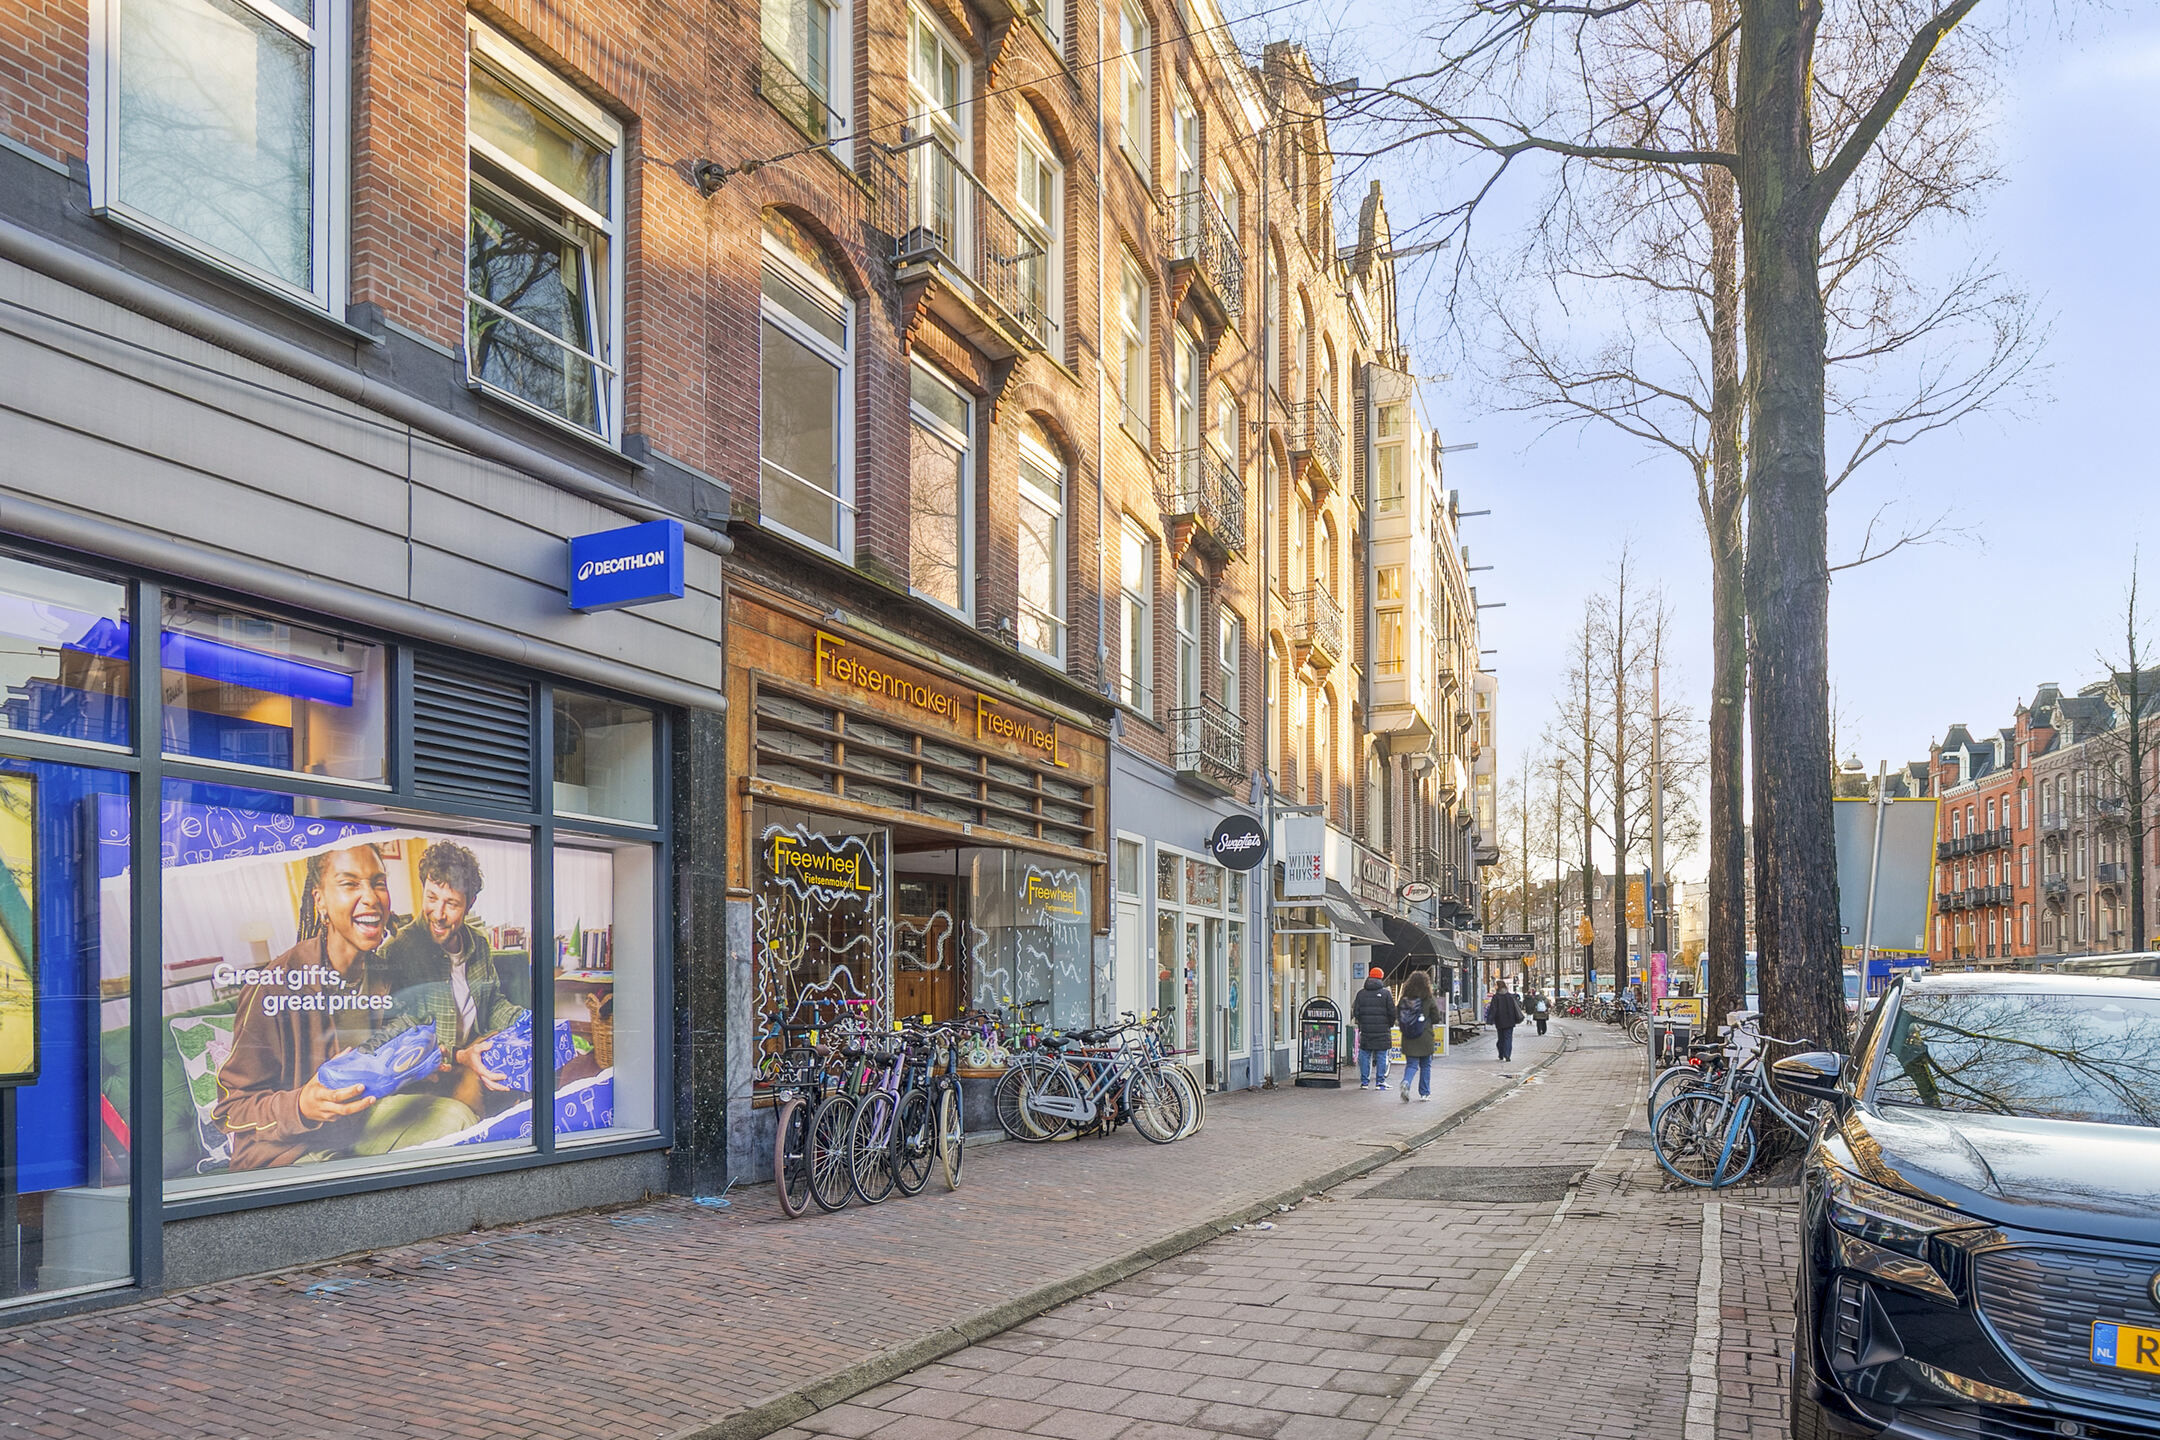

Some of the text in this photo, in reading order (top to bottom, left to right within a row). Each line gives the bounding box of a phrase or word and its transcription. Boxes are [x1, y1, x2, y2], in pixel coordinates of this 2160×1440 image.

[594, 550, 665, 576] DECATHLON
[814, 629, 961, 724] Fietsenmakerij
[1216, 832, 1261, 853] Swapfiets
[1288, 854, 1313, 868] WIJN
[1289, 868, 1313, 881] HUYS
[213, 962, 347, 991] Great gifts,
[262, 989, 394, 1017] great prices
[2096, 1346, 2114, 1359] NL
